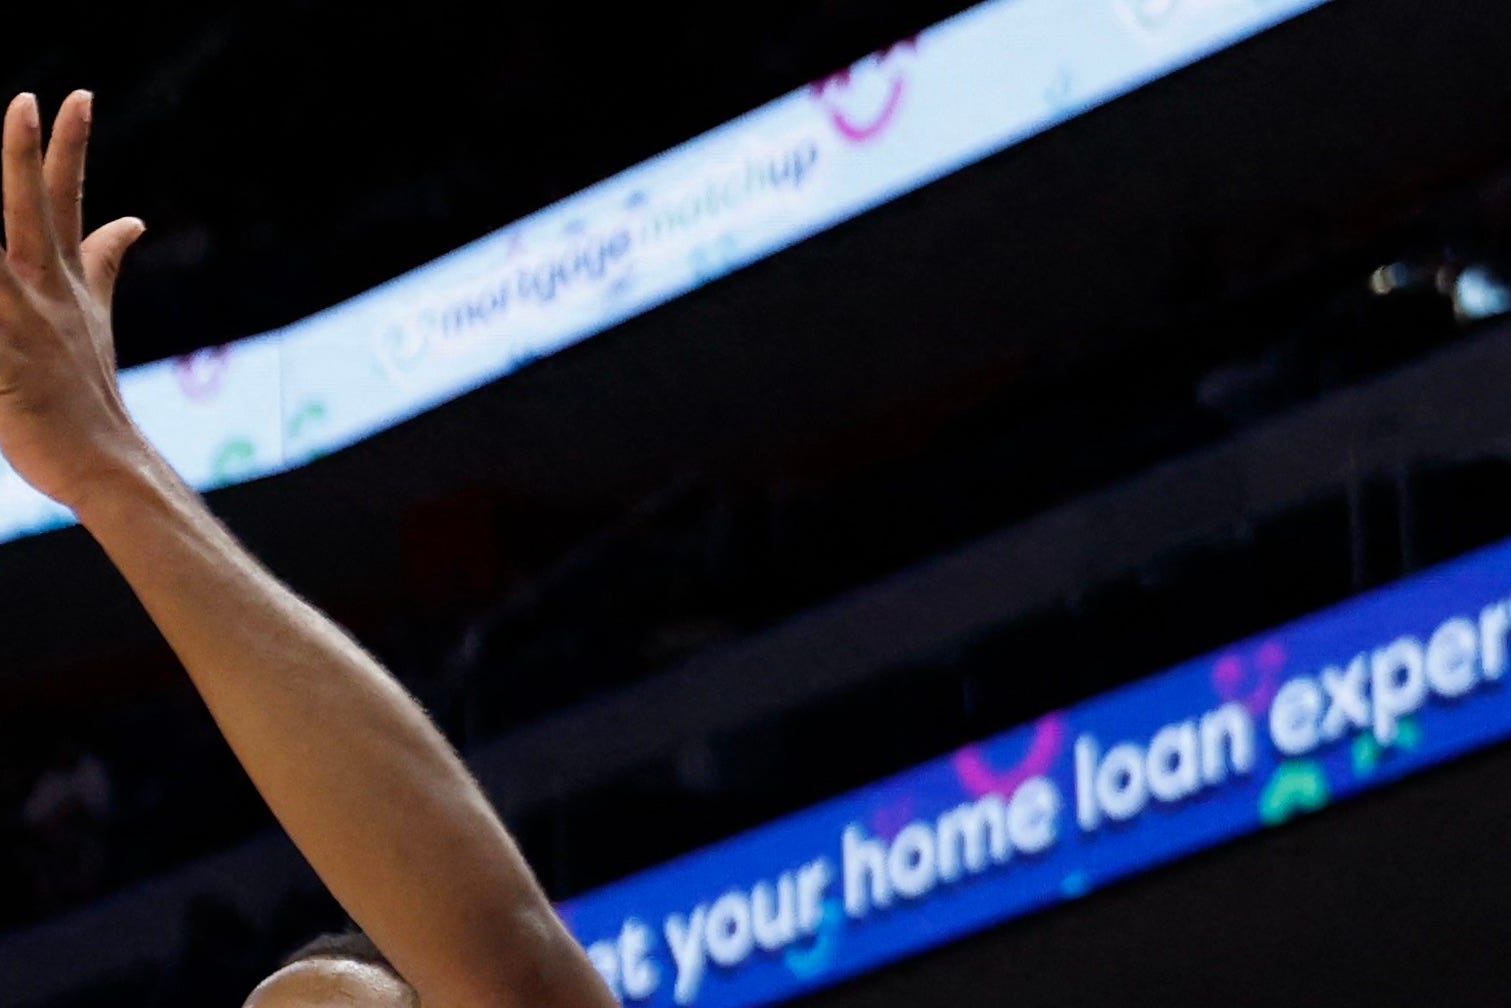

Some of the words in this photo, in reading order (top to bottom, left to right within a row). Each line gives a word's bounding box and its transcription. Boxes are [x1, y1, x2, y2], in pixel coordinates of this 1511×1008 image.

[662, 858, 829, 1006] your
[843, 774, 1059, 917] home
[1075, 702, 1255, 831] loan
[1269, 597, 1511, 752] exper
